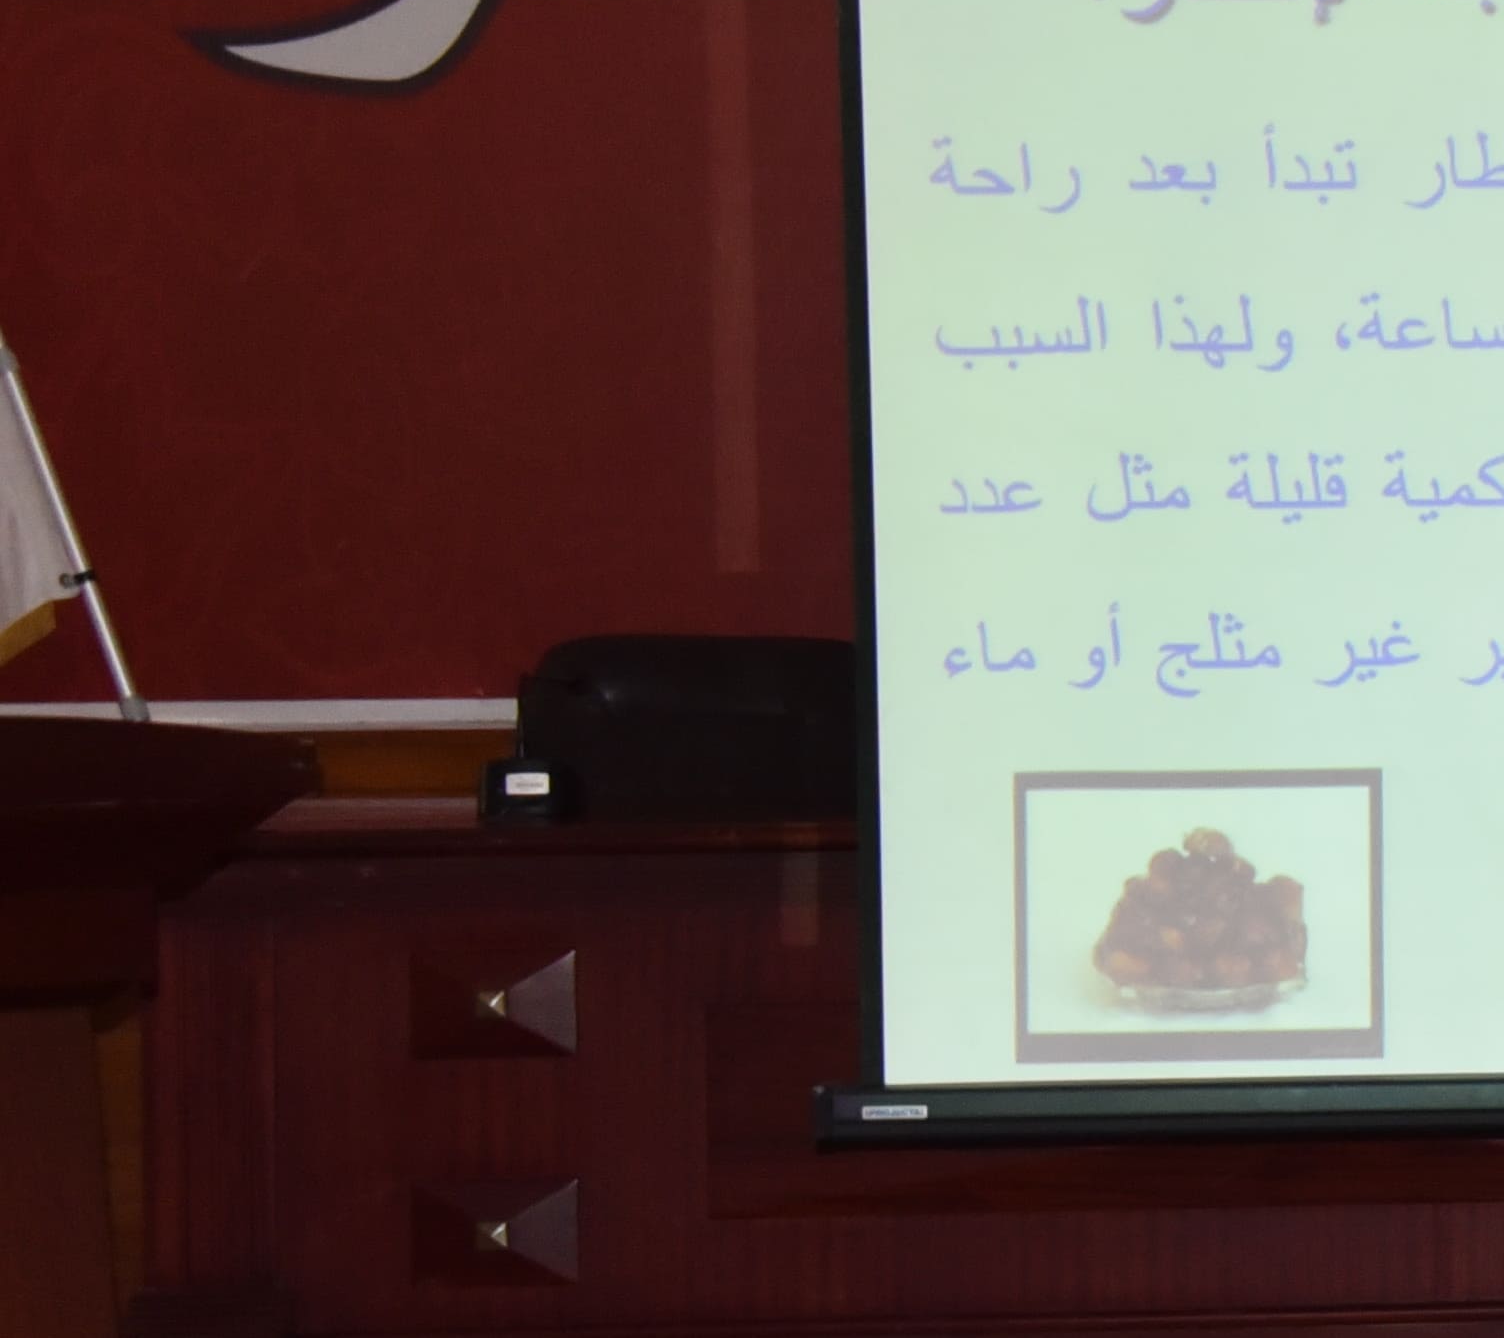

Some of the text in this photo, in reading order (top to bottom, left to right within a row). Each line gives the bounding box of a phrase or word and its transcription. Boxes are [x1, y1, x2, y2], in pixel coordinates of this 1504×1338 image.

[928, 134, 1083, 215] راحة
[1127, 153, 1219, 207] بعد
[1263, 123, 1359, 206] تبدأ
[934, 293, 1109, 372] السبب
[1151, 292, 1296, 374] ولهذا
[938, 476, 1041, 517] عدد
[1085, 450, 1193, 525] مثل
[1224, 450, 1349, 526] قليلة
[942, 619, 1038, 679] ماء
[1071, 601, 1122, 692] أو
[1155, 610, 1284, 701] مثلج
[1318, 618, 1420, 690] غير
